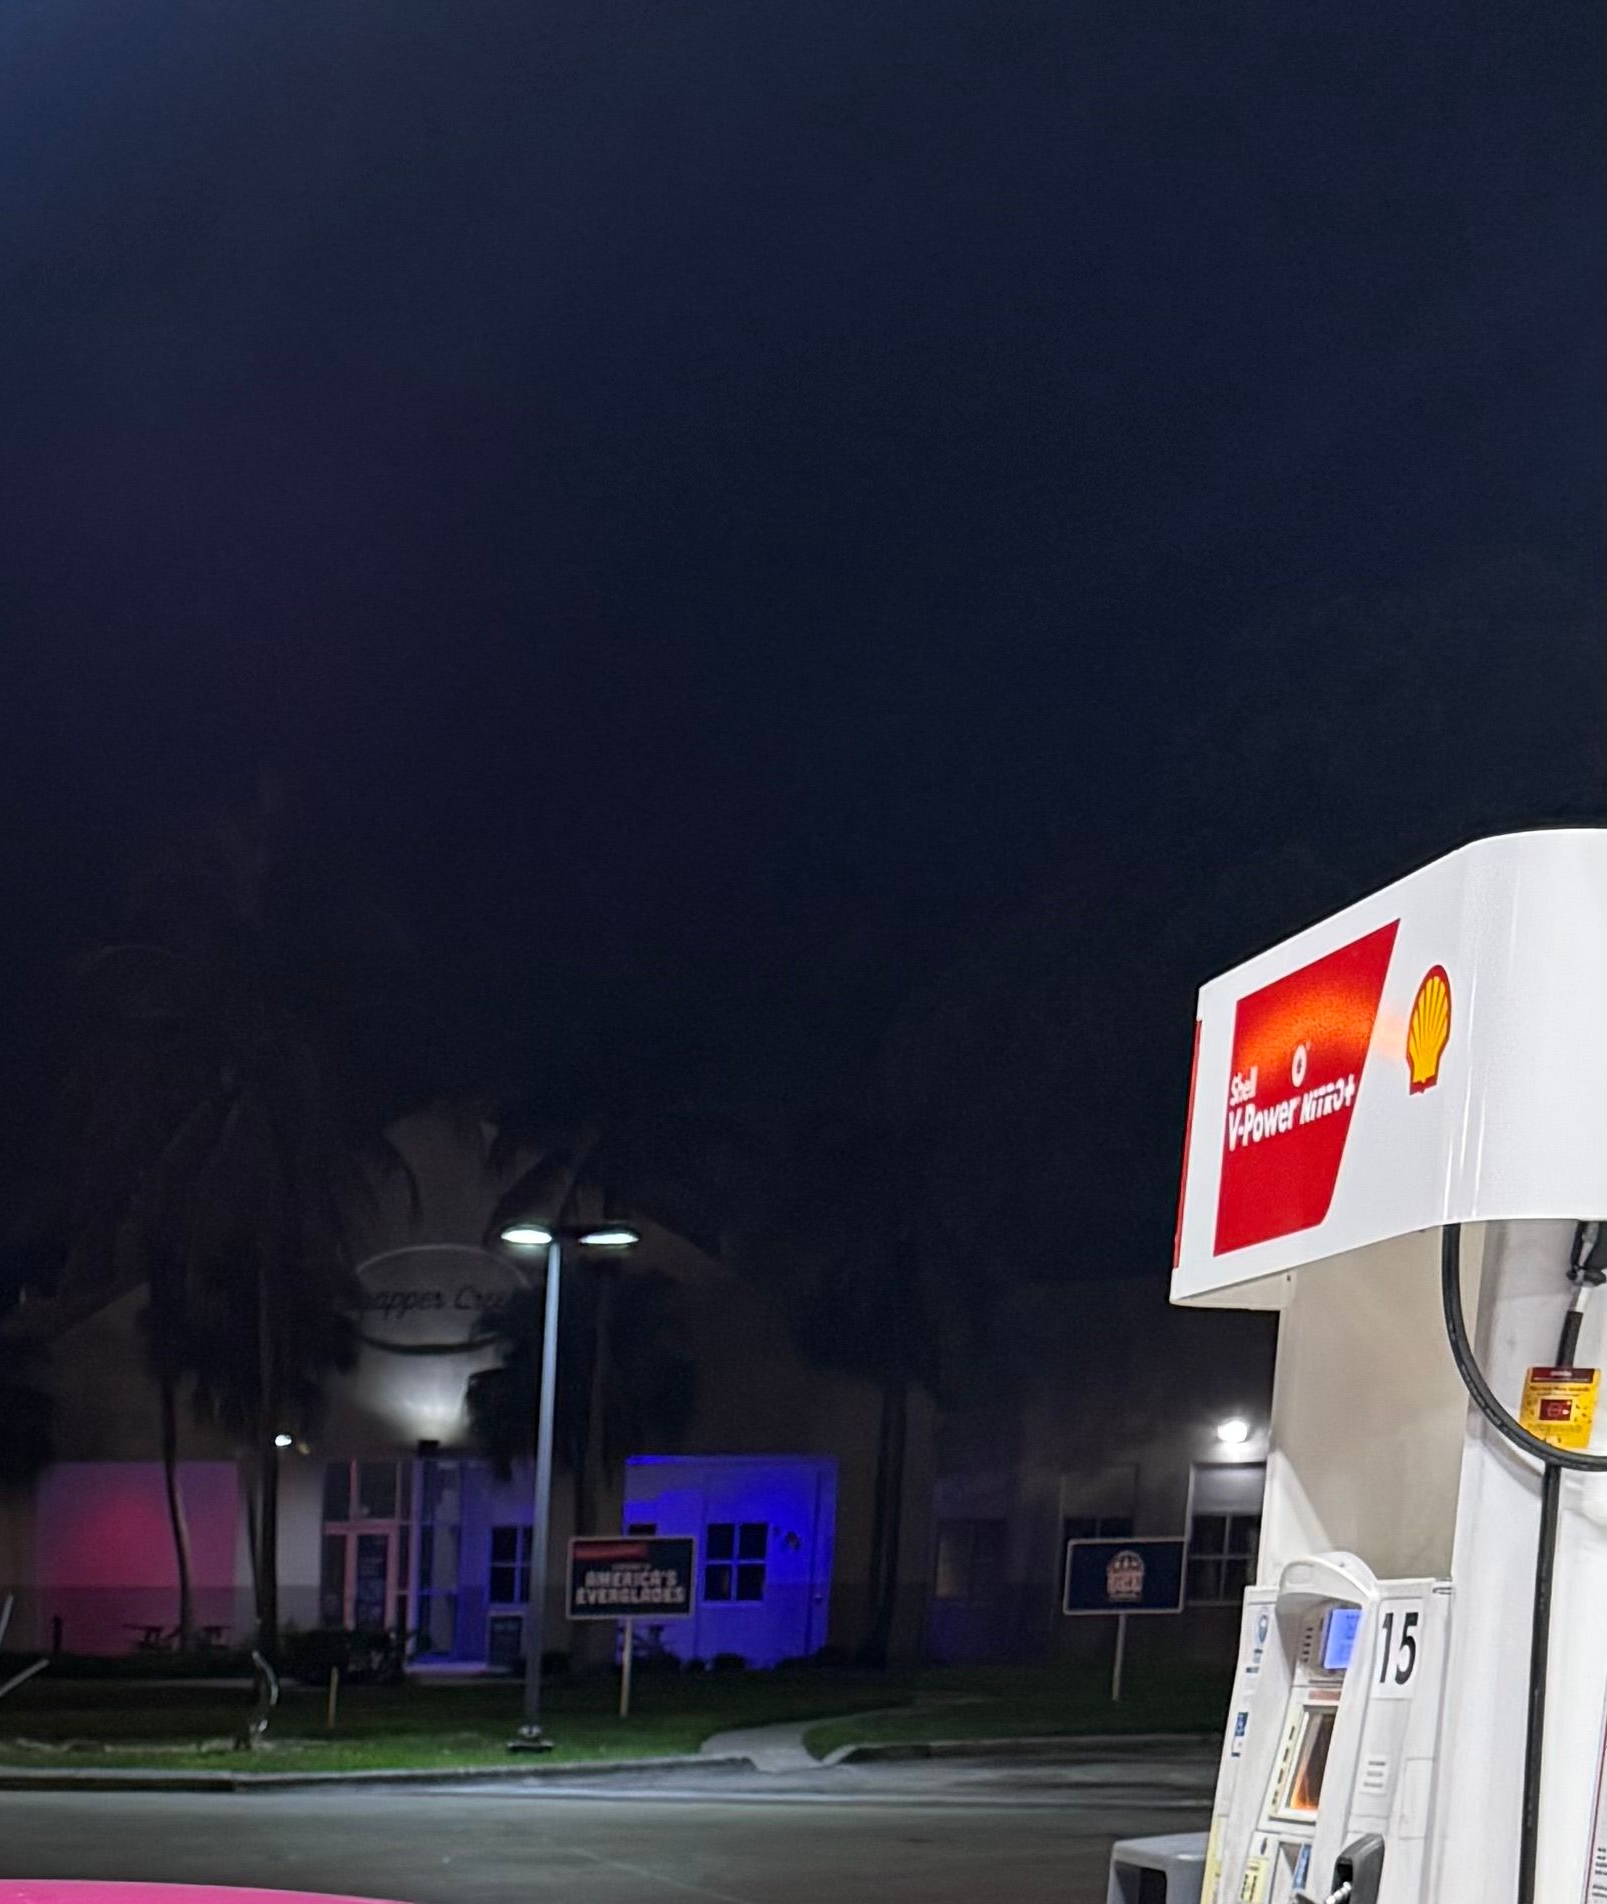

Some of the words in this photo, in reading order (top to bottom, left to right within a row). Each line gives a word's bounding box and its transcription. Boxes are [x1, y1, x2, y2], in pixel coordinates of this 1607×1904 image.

[1230, 1065, 1258, 1106] Shell
[1228, 1096, 1301, 1152] V-Power
[575, 1587, 686, 1605] EVERGLADES
[1379, 1611, 1419, 1686] 15
